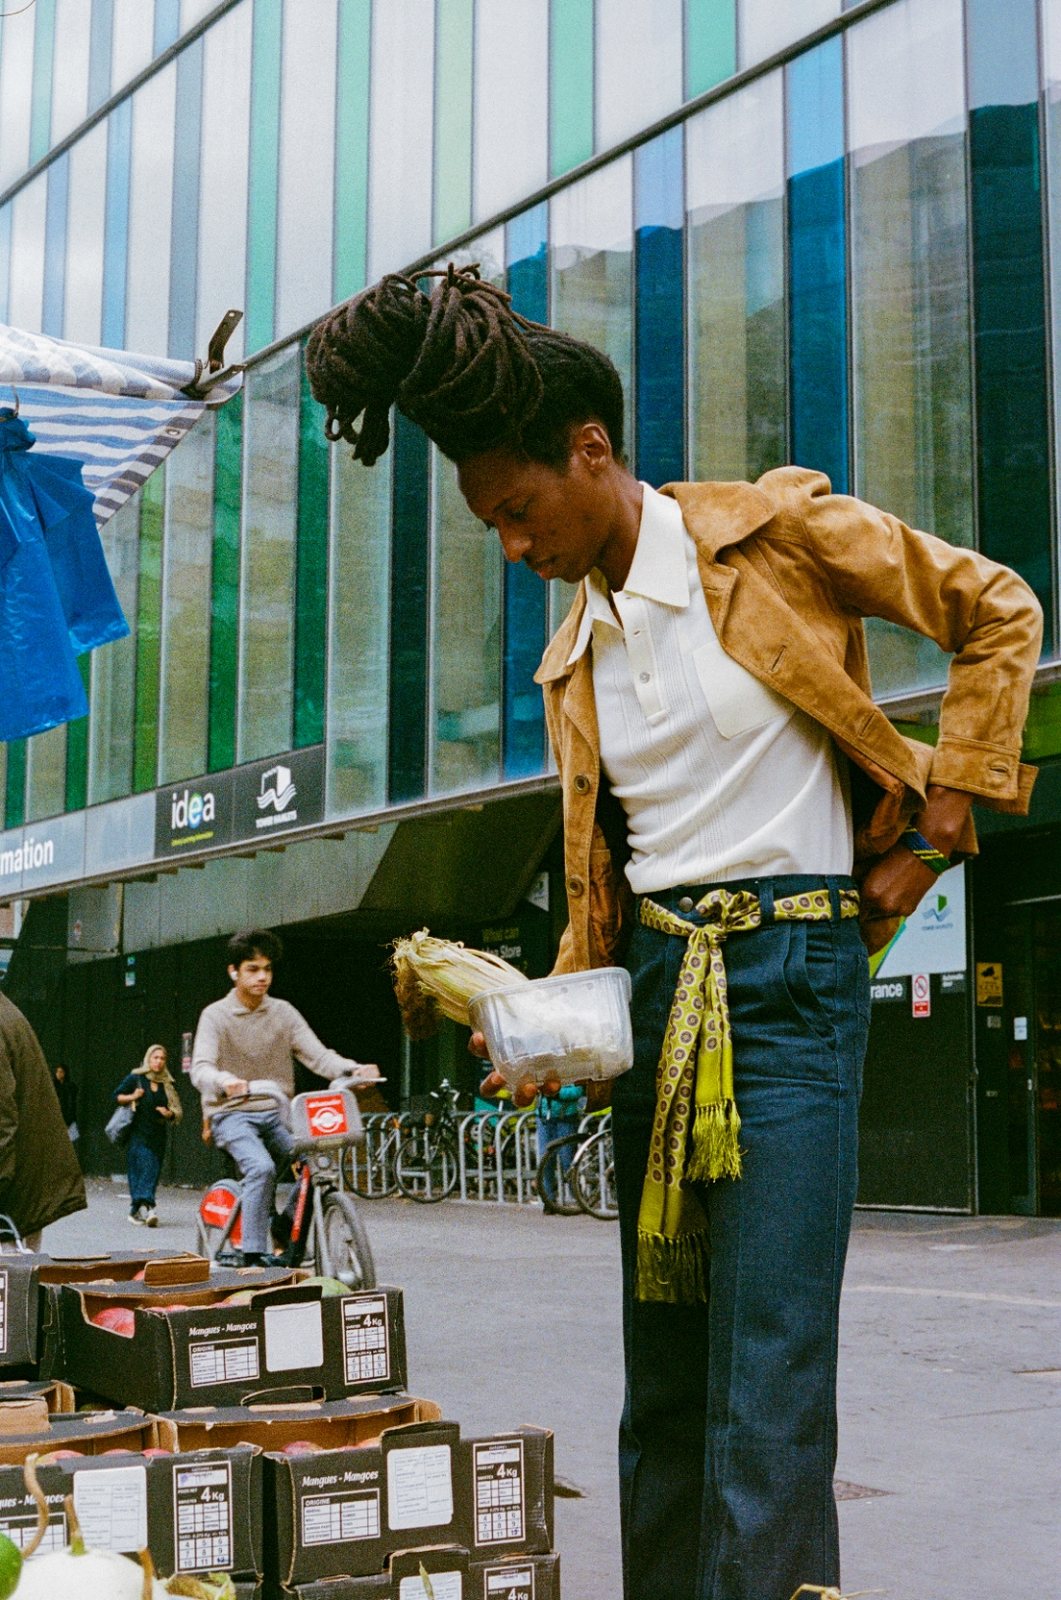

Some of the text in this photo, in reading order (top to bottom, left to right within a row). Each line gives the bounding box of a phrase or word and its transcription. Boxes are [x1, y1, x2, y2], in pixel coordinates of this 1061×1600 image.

[171, 790, 215, 830] idea
[0, 838, 54, 876] mation
[870, 983, 903, 1000] rance
[363, 1314, 372, 1328] 4
[372, 1318, 383, 1327] Kg
[189, 1326, 221, 1337] Mangues
[225, 1322, 257, 1333] Mangoes
[496, 1463, 506, 1479] 4
[506, 1468, 518, 1478] Kg
[302, 1475, 338, 1489] Mangues
[343, 1471, 379, 1484] Mangoes
[200, 1486, 212, 1502] 4
[212, 1492, 225, 1502] Kg
[507, 1587, 517, 1600] 4
